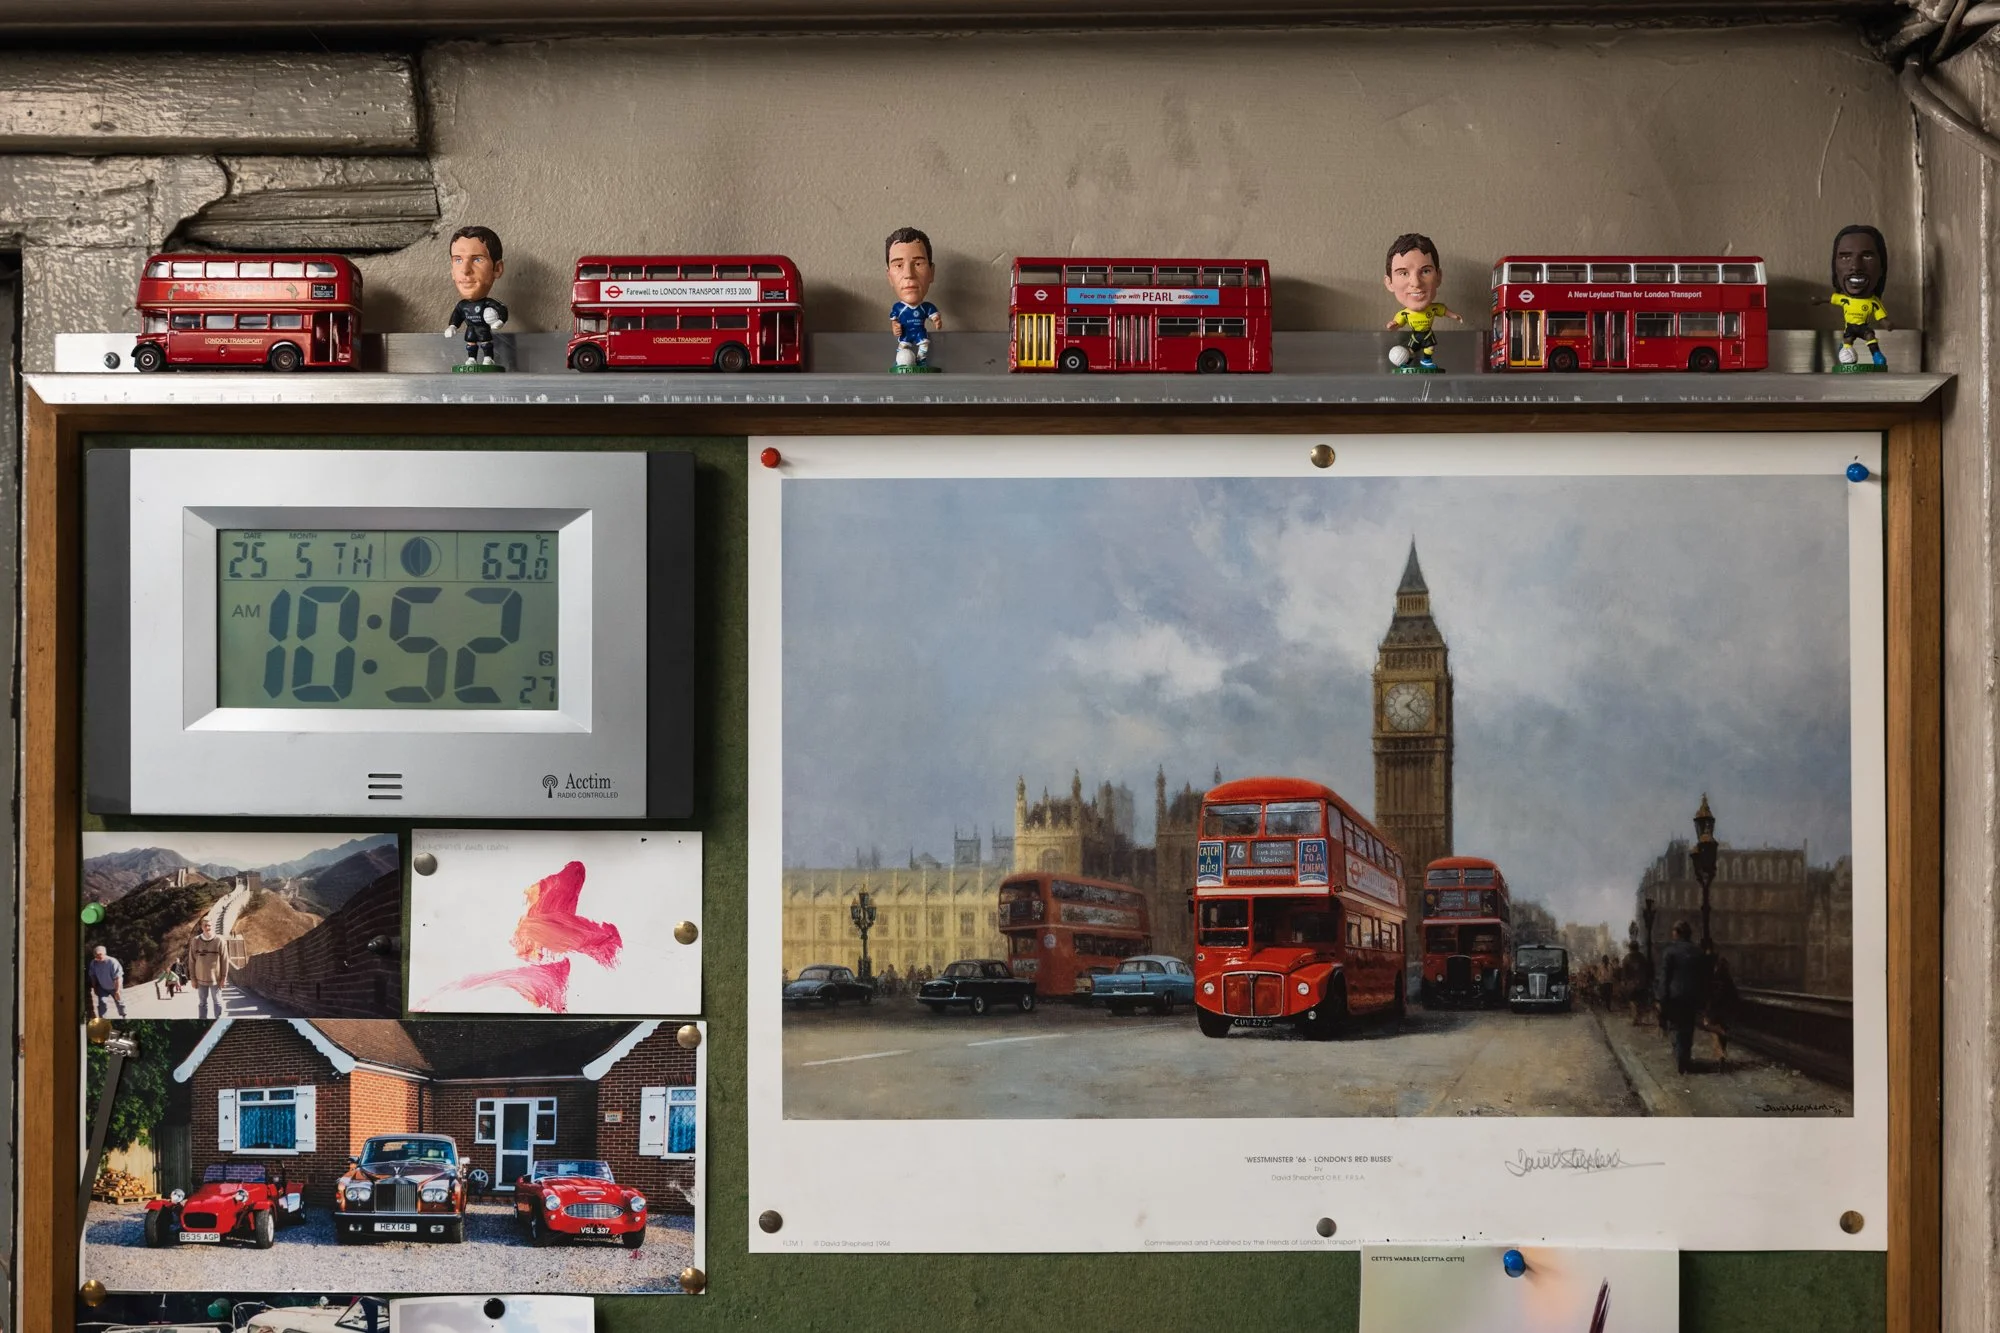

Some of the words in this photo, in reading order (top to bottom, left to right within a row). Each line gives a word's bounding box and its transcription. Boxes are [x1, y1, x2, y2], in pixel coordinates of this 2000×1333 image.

[627, 287, 650, 295] Farewell
[660, 287, 686, 295] LONDON
[725, 287, 737, 295] 1933
[738, 287, 752, 295] 2000
[1589, 291, 1615, 300] Leyland
[1670, 291, 1702, 300] Transport
[1142, 292, 1173, 302] PEARL
[243, 532, 263, 540] DATE
[289, 532, 318, 540] MONTH
[229, 541, 268, 579] 25
[295, 542, 313, 579] 5
[333, 542, 374, 579] TH
[231, 604, 261, 618] AM
[263, 586, 523, 703] 10:52
[519, 676, 556, 703] 27
[565, 772, 612, 790] Acctim
[557, 791, 576, 799] RADIO
[577, 791, 619, 799] CONTROLLED
[1199, 846, 1220, 857] CATCH
[1229, 844, 1245, 859] 76
[1306, 844, 1318, 853] GO
[1206, 856, 1212, 865] A
[1303, 853, 1314, 862] TO
[1316, 853, 1323, 861] A
[1200, 864, 1219, 874] BUS!
[1301, 863, 1325, 873] CINEMA
[1292, 1174, 1325, 1182] Shepherd
[180, 1233, 202, 1241] B535
[204, 1233, 219, 1241] AGP
[841, 1240, 873, 1248] Shepherd
[1144, 1239, 1193, 1247] Commissioned
[1243, 1239, 1252, 1247] by
[1326, 1238, 1357, 1247] Transport
